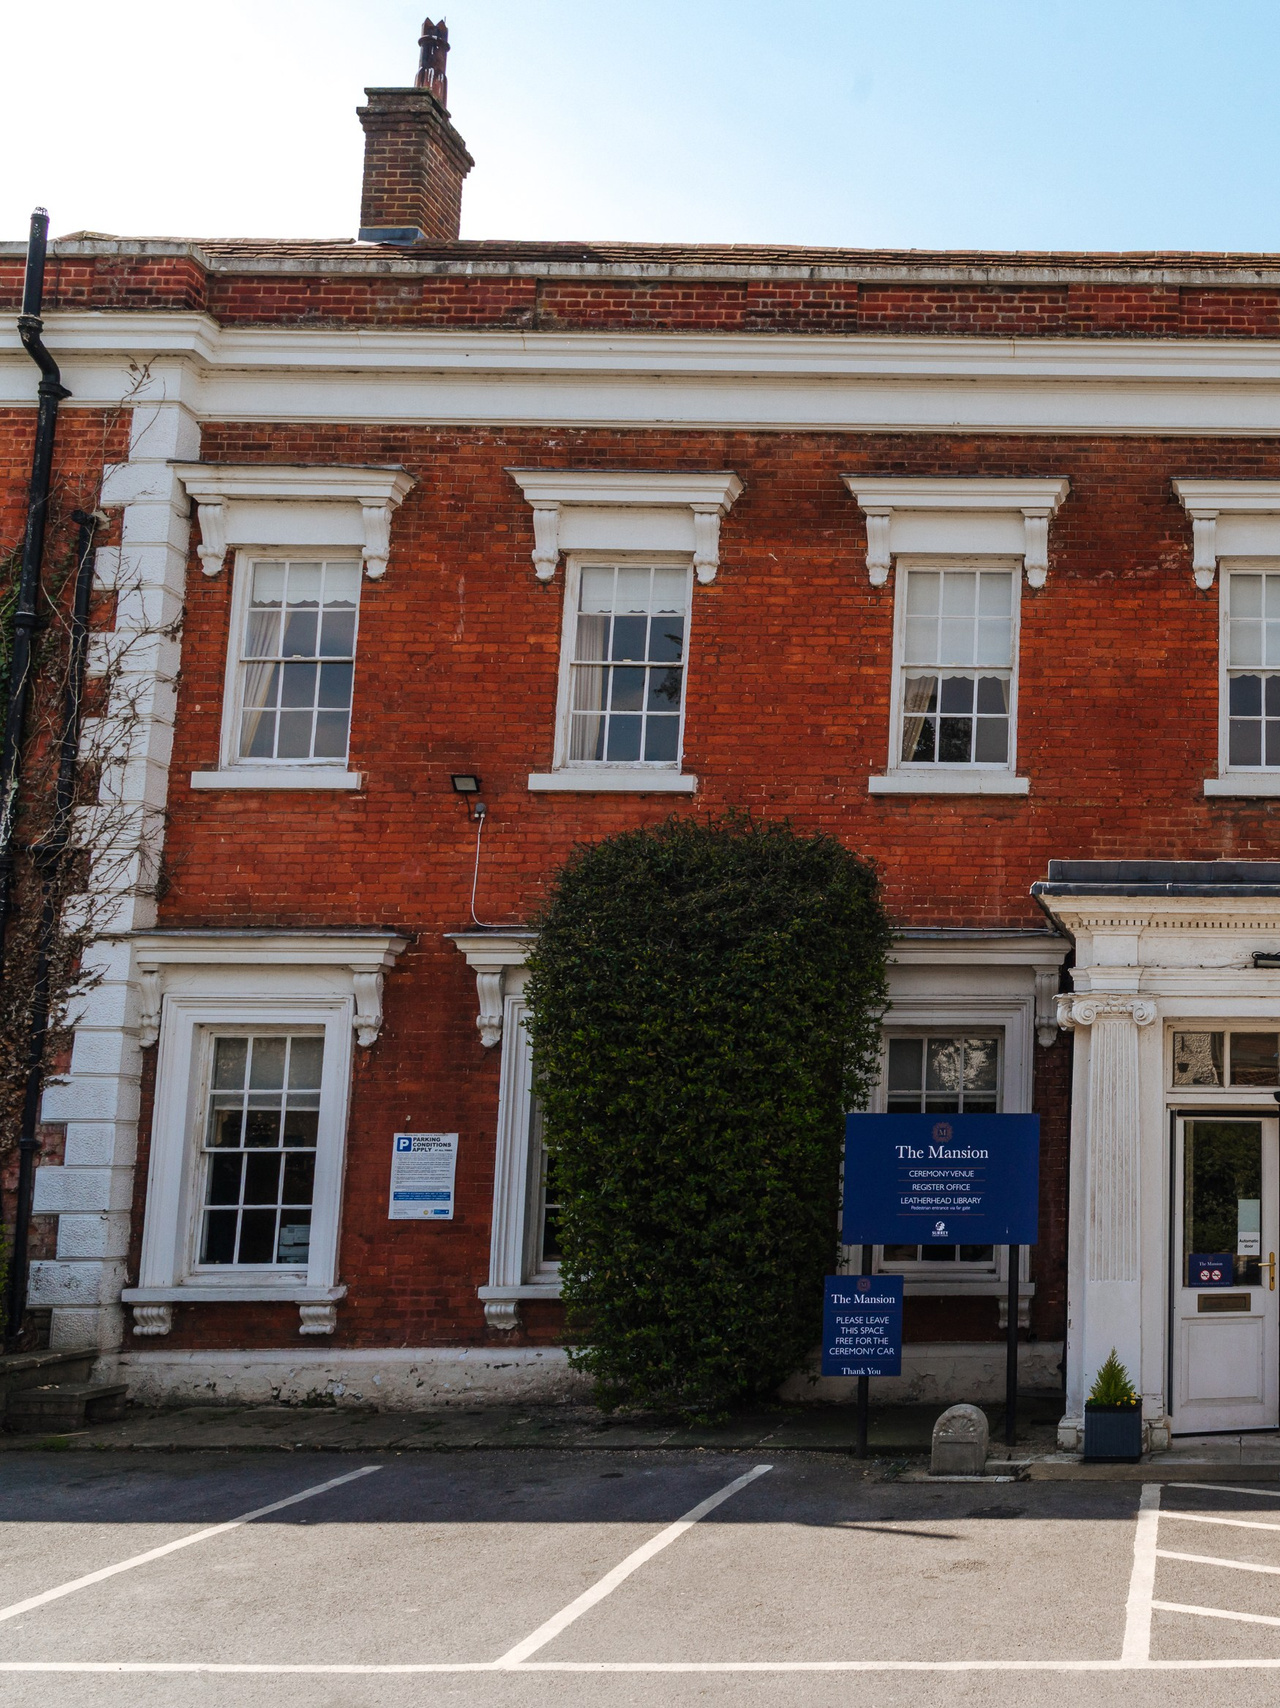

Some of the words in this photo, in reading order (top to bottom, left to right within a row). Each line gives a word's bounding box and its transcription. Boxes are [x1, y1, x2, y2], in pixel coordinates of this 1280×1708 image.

[895, 1145, 924, 1159] The
[928, 1145, 989, 1159] Mansion
[950, 1170, 975, 1178] VENUE
[912, 1183, 945, 1191] REGISTER
[946, 1183, 971, 1191] OFFICE
[830, 1294, 851, 1304] The
[853, 1294, 895, 1304] Mansion
[836, 1316, 864, 1324] PLEASE
[865, 1316, 890, 1324] LEAVE
[840, 1326, 859, 1334] THIS
[860, 1326, 884, 1334] SPACE
[835, 1337, 853, 1345] FREE
[855, 1337, 872, 1345] FOR
[873, 1337, 889, 1345] THE
[829, 1347, 875, 1355] CEREMONY
[876, 1347, 895, 1355] CAR
[841, 1367, 866, 1375] Thank
[866, 1367, 881, 1375] You
